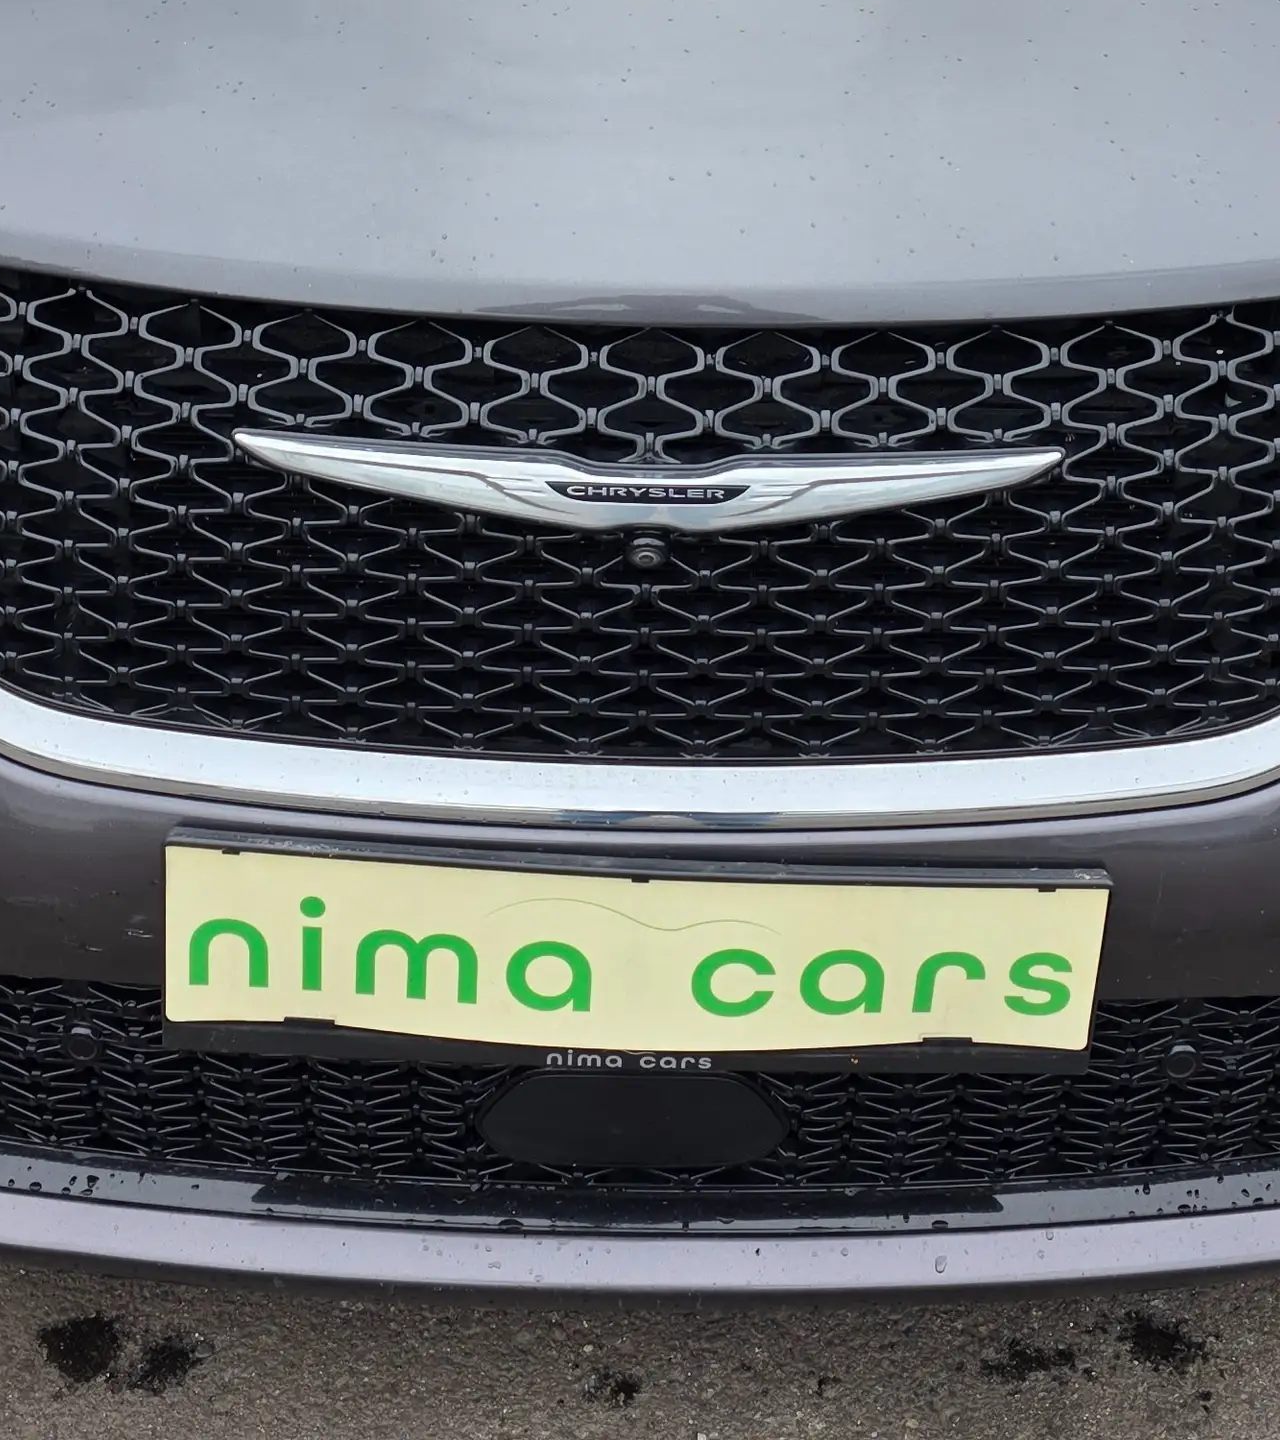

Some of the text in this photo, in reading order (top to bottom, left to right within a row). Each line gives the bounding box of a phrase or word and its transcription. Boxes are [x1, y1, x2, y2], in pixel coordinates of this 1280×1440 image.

[566, 485, 725, 500] CHRYSLER
[189, 896, 1071, 1017] nima cars
[546, 1049, 712, 1069] nima cars
